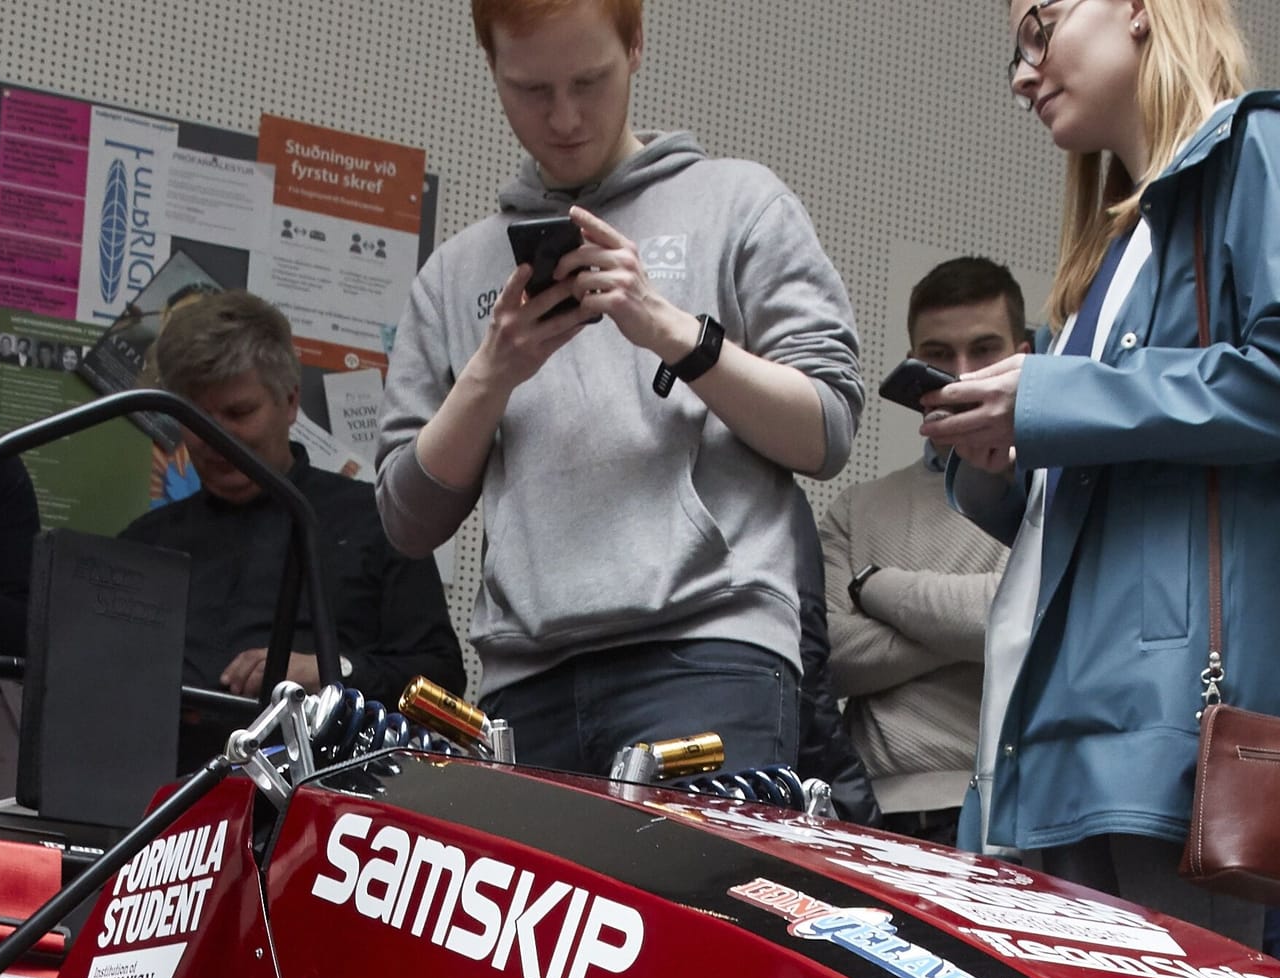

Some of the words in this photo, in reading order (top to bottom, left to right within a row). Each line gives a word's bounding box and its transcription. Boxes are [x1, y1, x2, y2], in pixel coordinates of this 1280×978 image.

[285, 138, 371, 171] Stuðningur
[374, 160, 397, 177] við
[290, 159, 339, 185] fyrstu
[342, 172, 385, 194] skref
[647, 270, 687, 281] ORTH
[477, 286, 504, 320] SP
[343, 405, 378, 418] KNOW
[347, 418, 378, 431] YOUR
[113, 820, 228, 897] FORMULA
[97, 876, 213, 949] STUDENT
